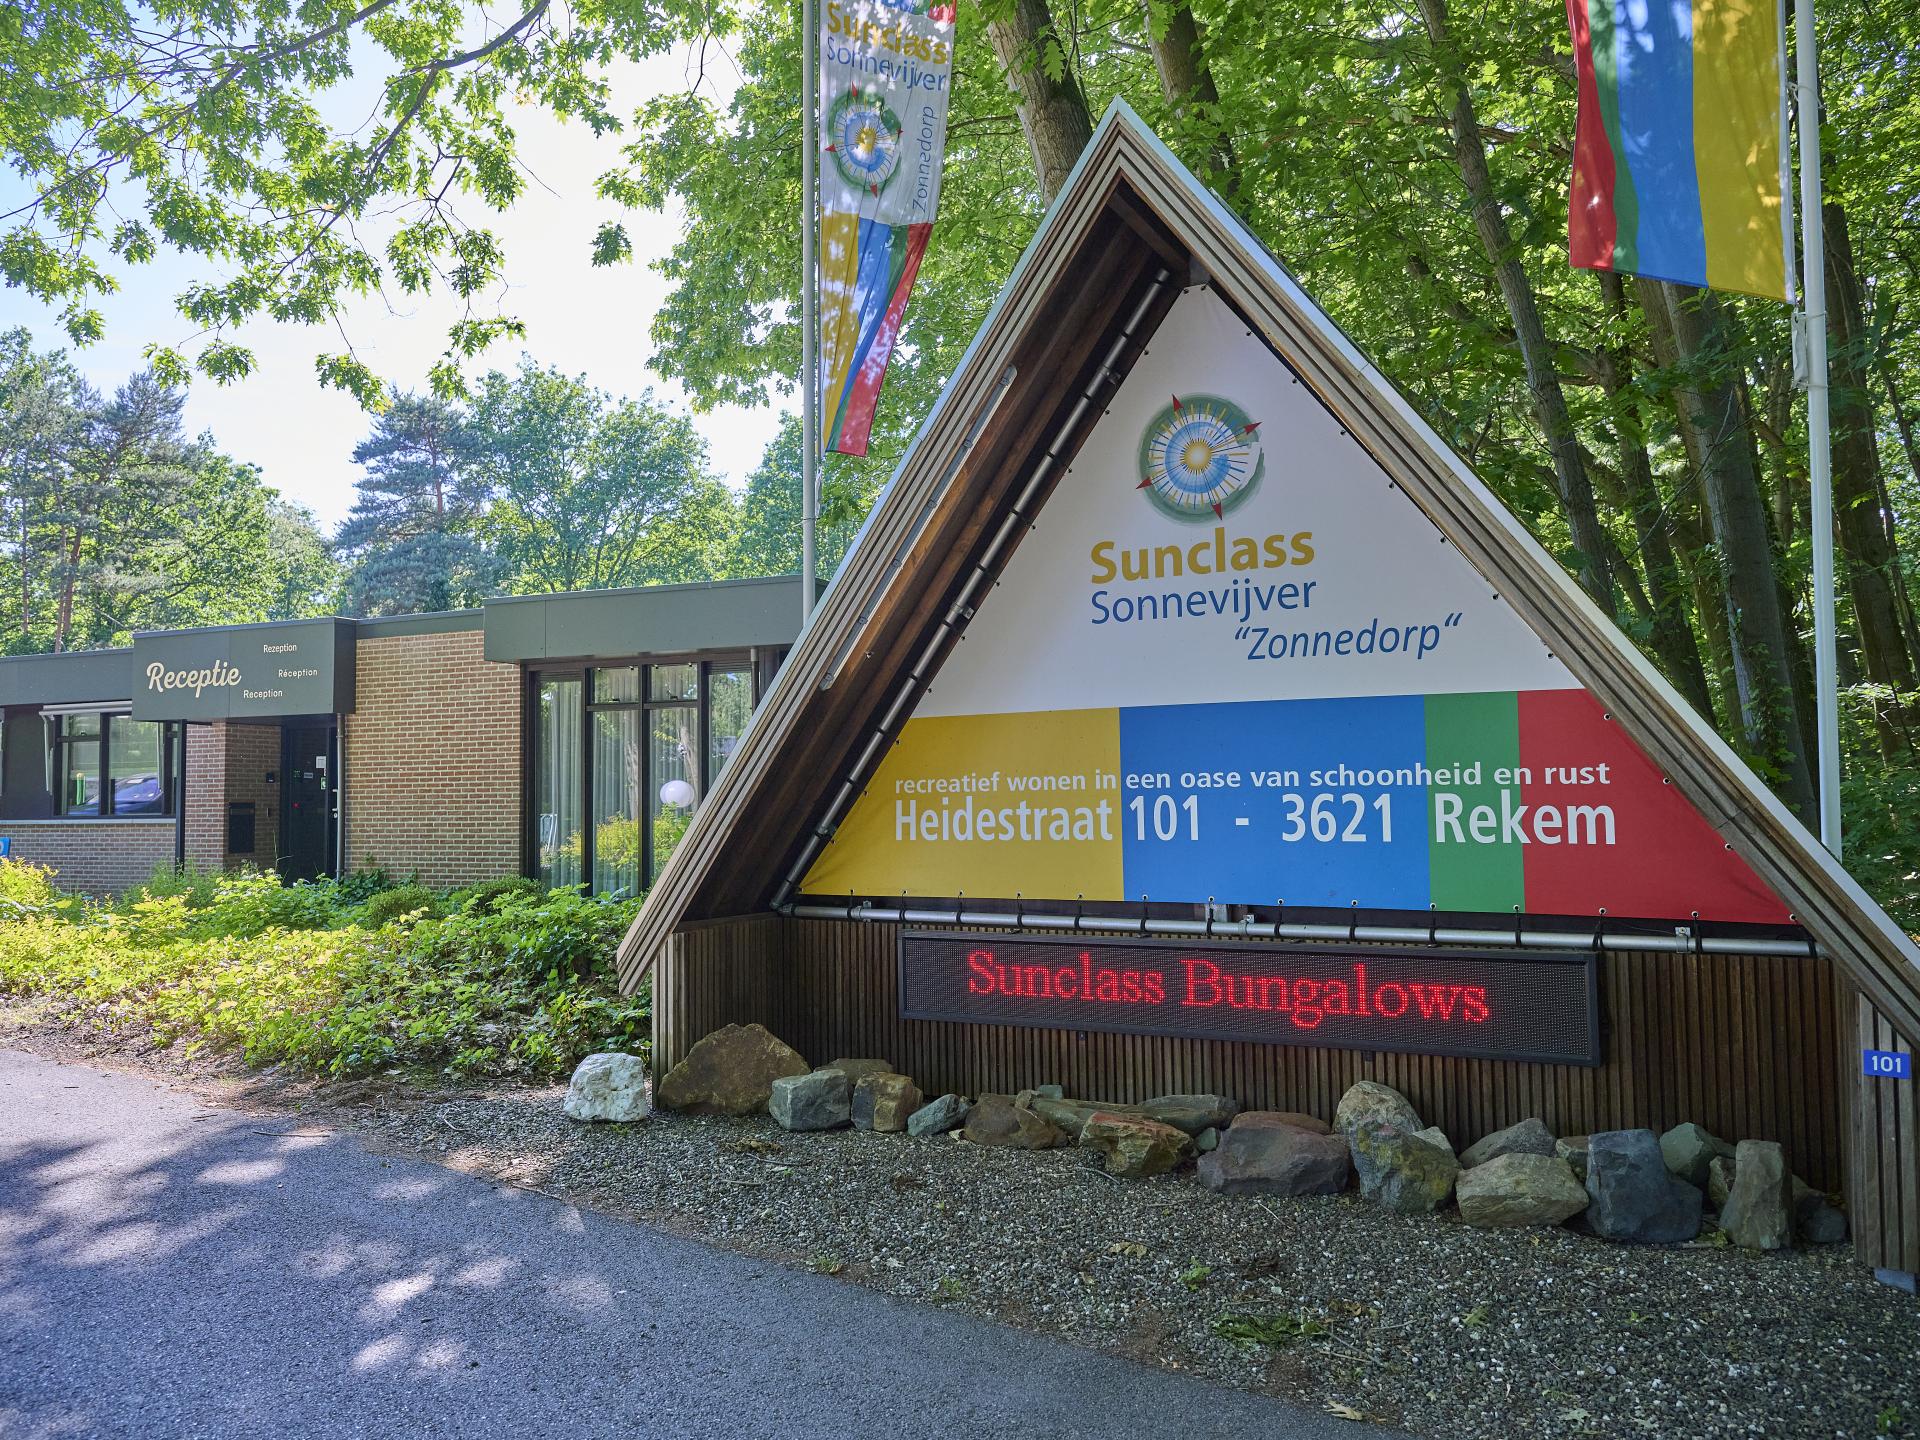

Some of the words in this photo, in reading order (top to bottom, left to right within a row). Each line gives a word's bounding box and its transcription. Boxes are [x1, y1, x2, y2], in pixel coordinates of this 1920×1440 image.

[827, 2, 947, 65] Sunclass
[827, 36, 947, 91] Sonnevijver
[912, 106, 938, 213] Zonnedorp
[1090, 527, 1315, 585] Sunclass
[1091, 578, 1317, 625] Sonnevijver
[263, 643, 297, 654] Rezeption
[146, 659, 242, 698] Receptie
[243, 688, 283, 700] Reception
[278, 668, 318, 679] Réception
[895, 772, 1000, 794] recreatief
[1007, 774, 1086, 792] wonen
[1095, 769, 1117, 790] in
[1125, 772, 1171, 789] een
[1180, 770, 1241, 788] oase
[1250, 769, 1299, 787] van
[1310, 762, 1481, 787] schoonheid
[1494, 767, 1532, 785] en
[1544, 763, 1611, 785] rust
[895, 796, 1113, 841] Heidestraat
[1129, 795, 1199, 841] 101
[1235, 817, 1250, 826] -
[1281, 793, 1392, 842] 3621
[1434, 789, 1616, 845] Rekem
[967, 951, 1164, 1003] Sunclass
[1180, 959, 1489, 1029] Bungalows
[1872, 1055, 1901, 1073] 101
